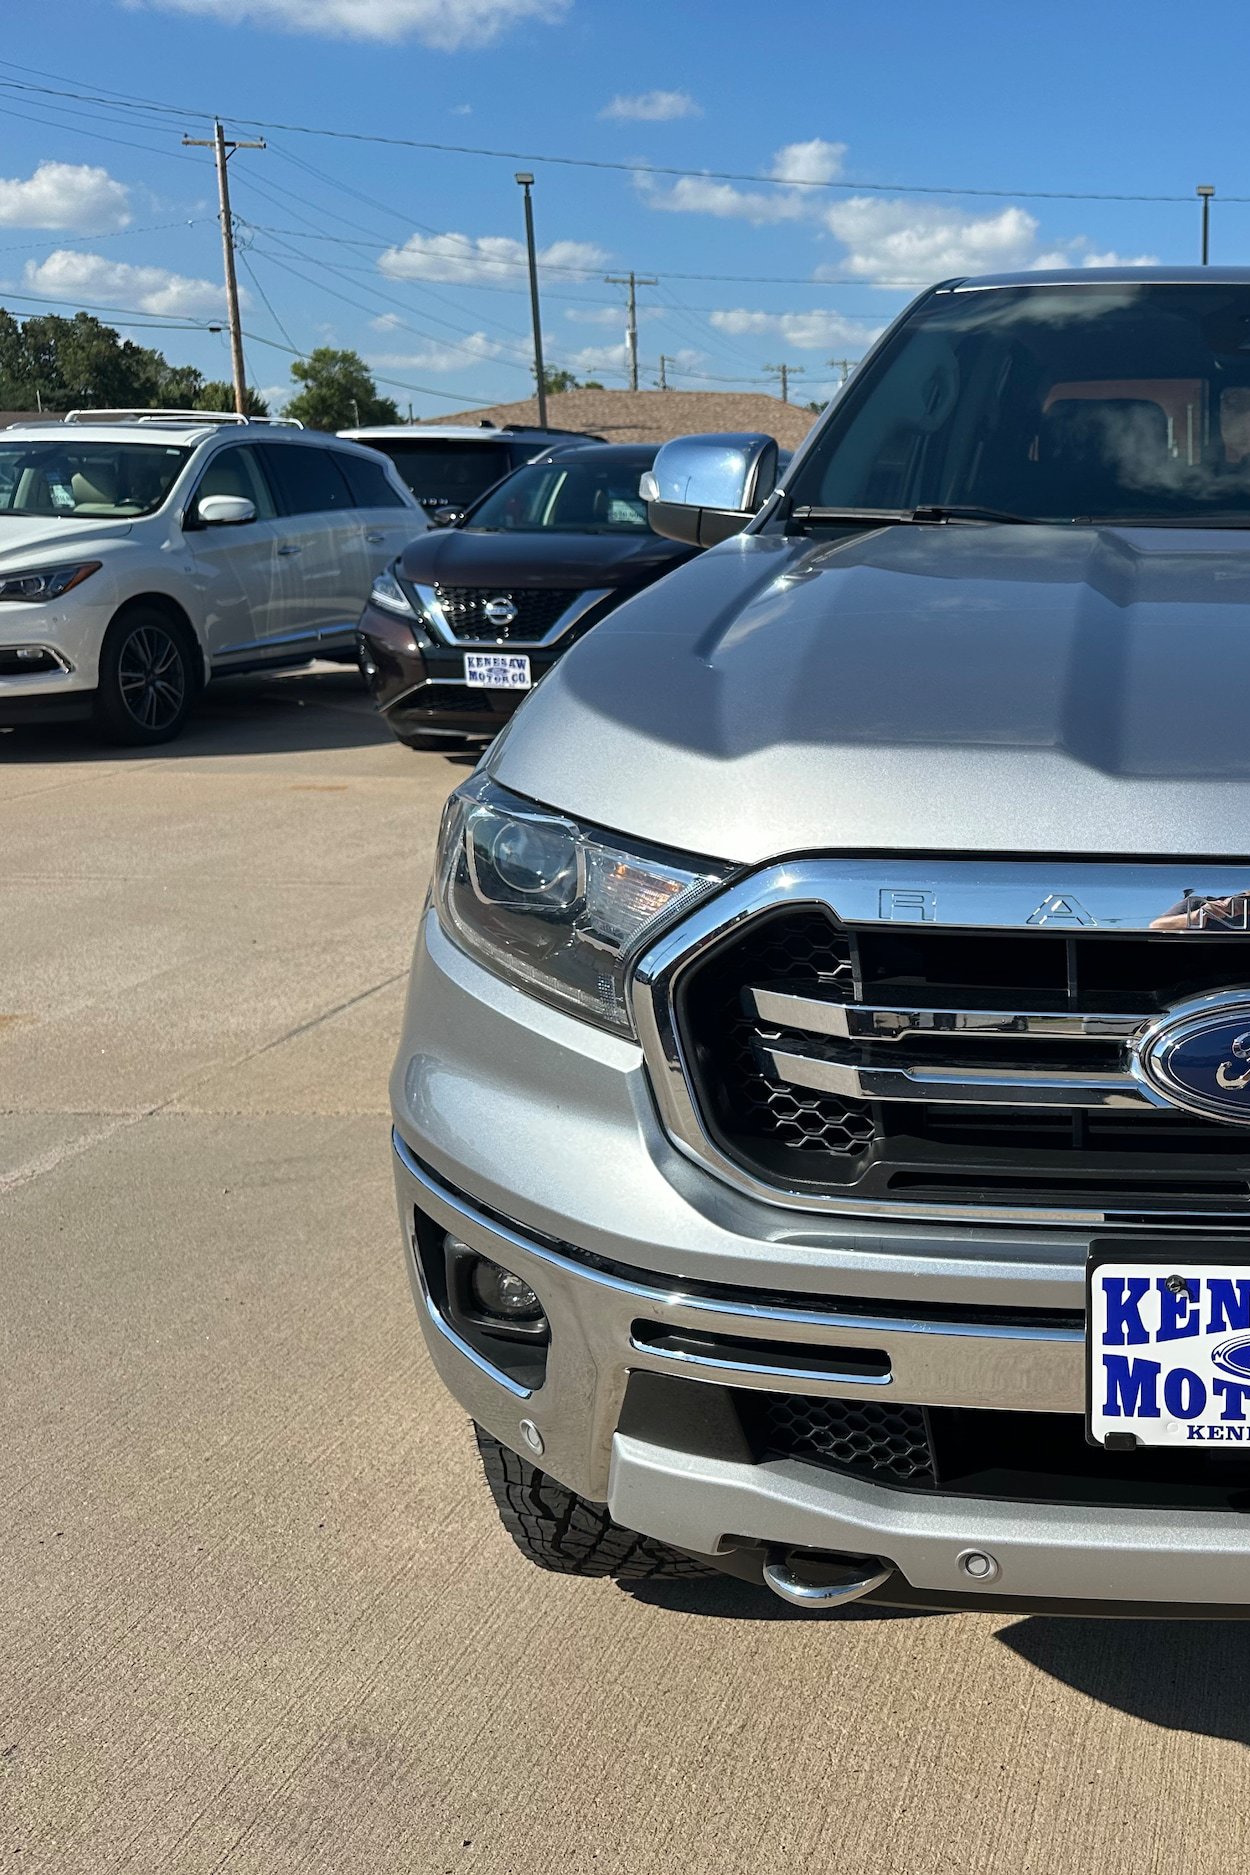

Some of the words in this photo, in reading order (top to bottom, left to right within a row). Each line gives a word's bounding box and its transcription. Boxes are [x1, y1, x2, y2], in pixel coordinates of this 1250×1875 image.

[467, 656, 527, 671] KENESAW
[468, 670, 509, 684] MOTOR
[511, 671, 529, 684] CO.
